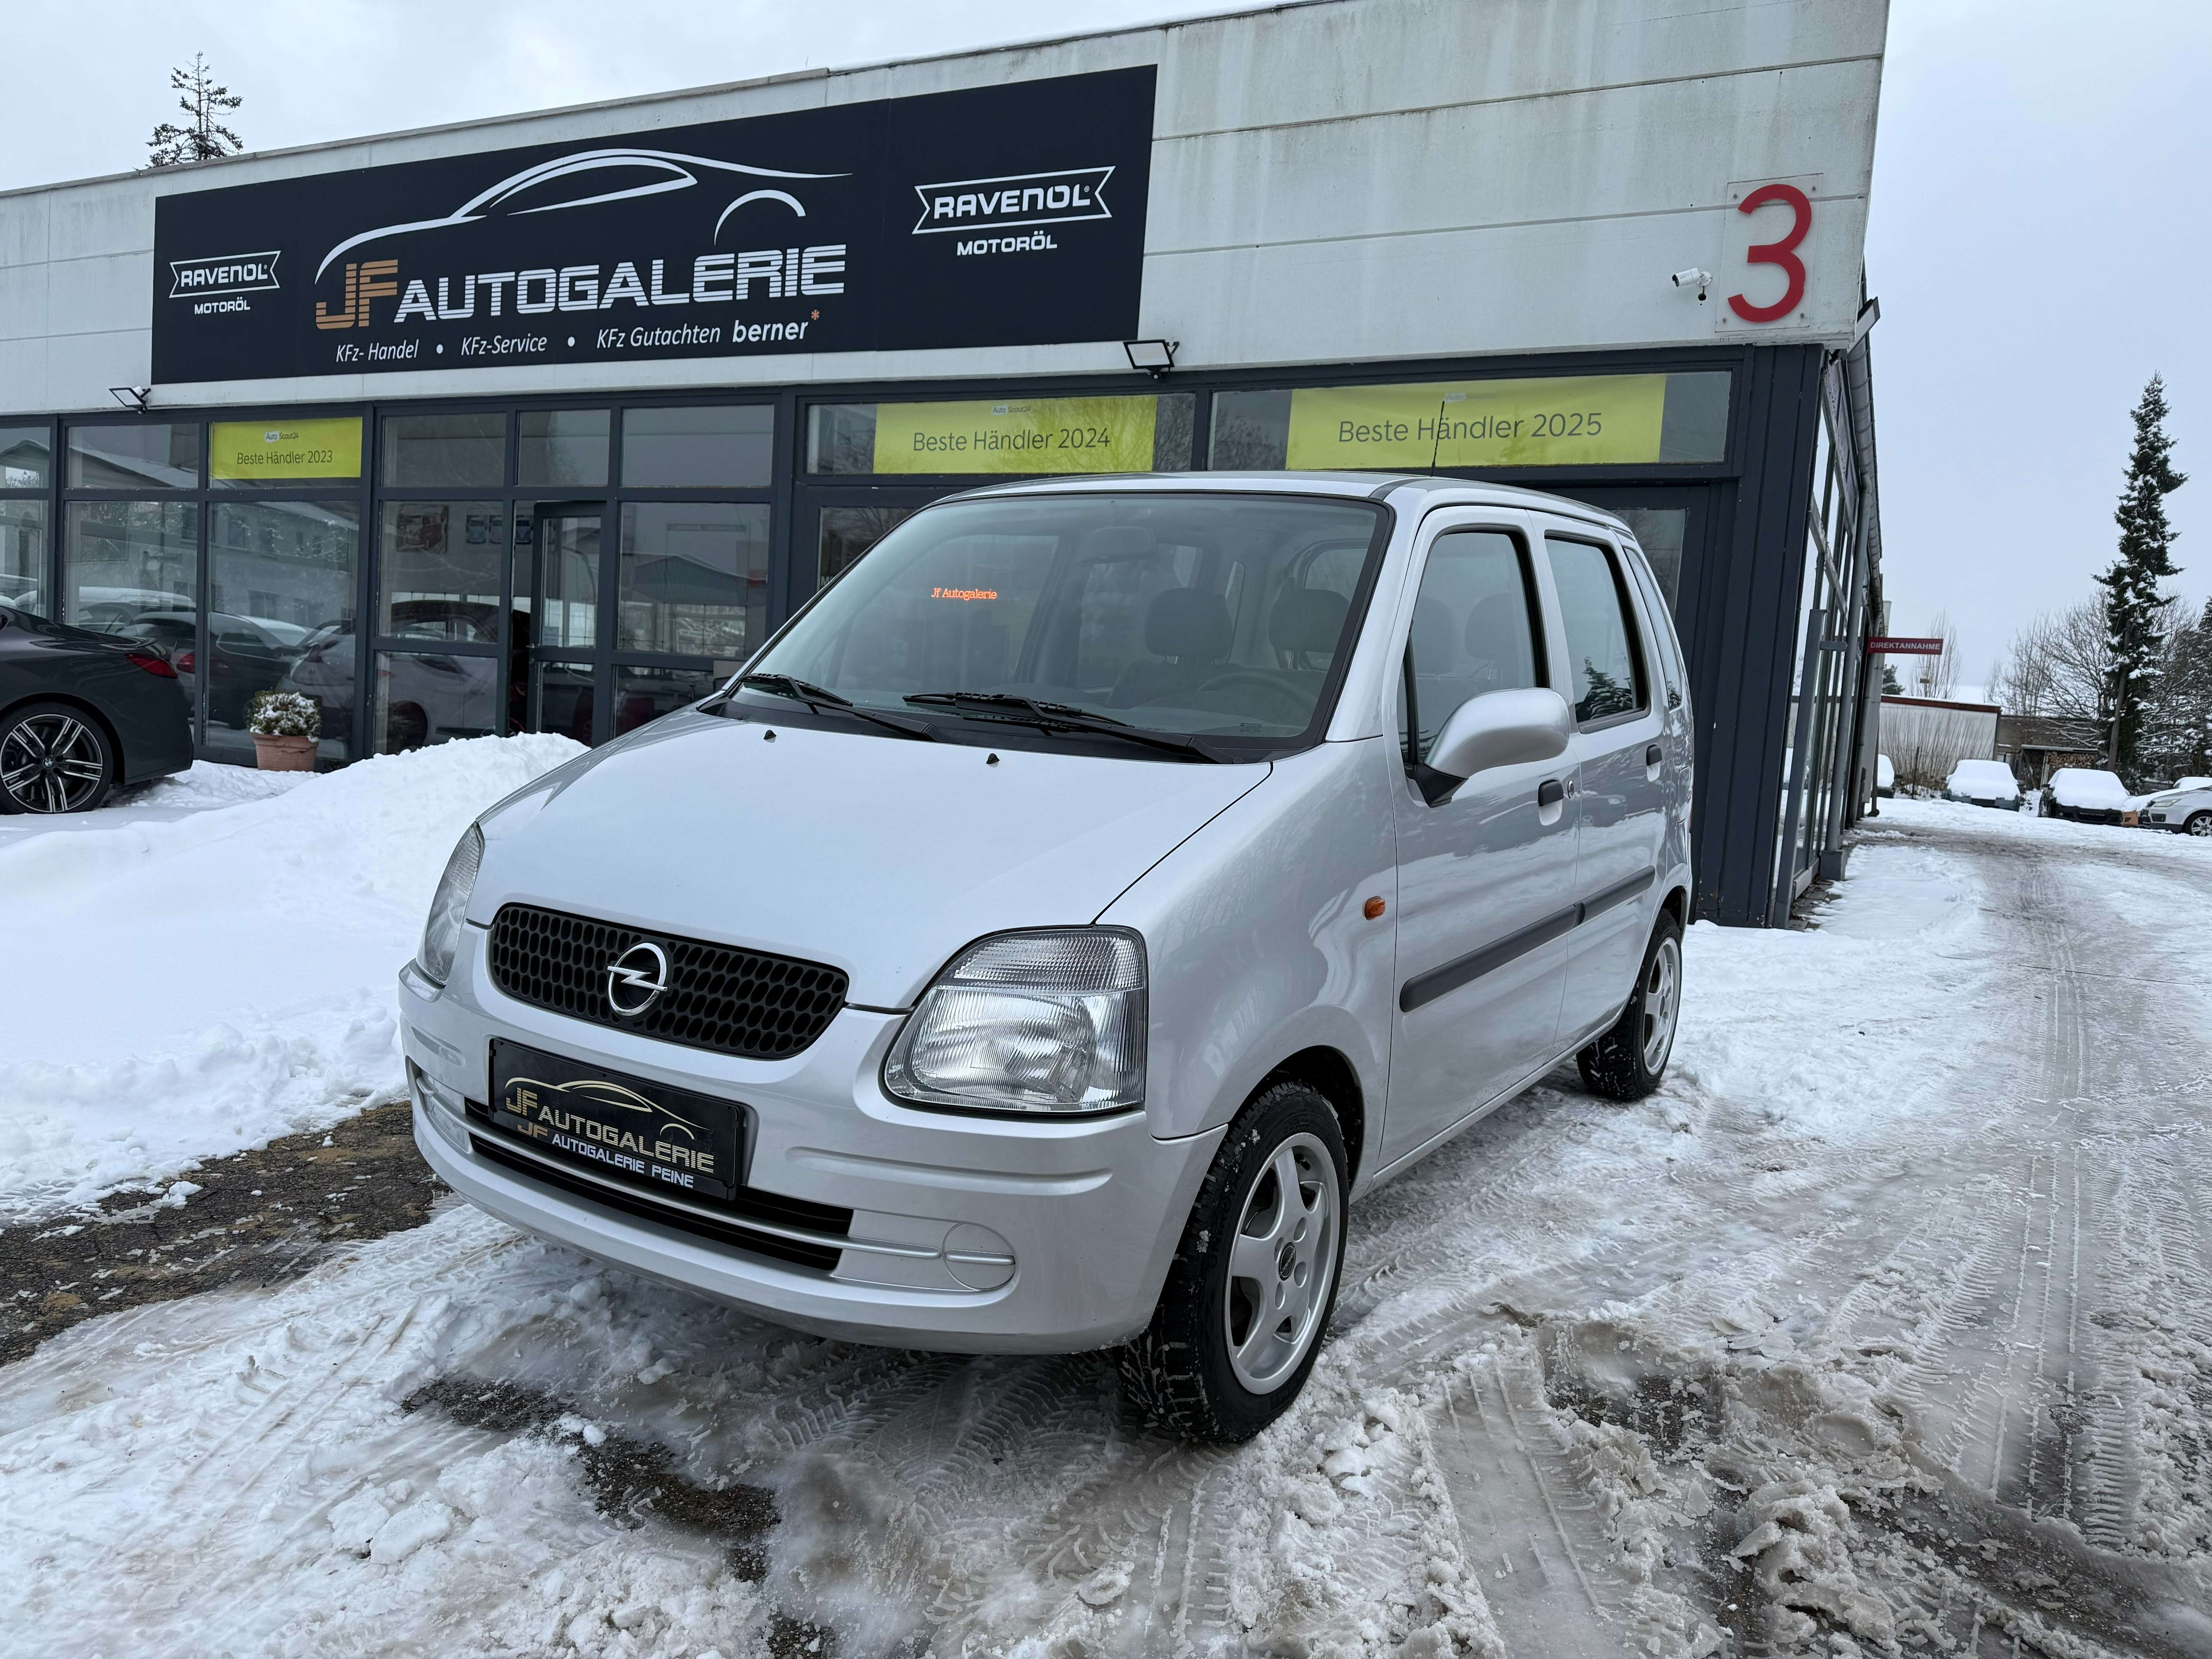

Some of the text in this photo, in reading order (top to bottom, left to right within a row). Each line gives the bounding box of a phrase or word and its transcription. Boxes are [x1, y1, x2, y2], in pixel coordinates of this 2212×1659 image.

[934, 184, 1091, 219] RAVENOL
[957, 230, 1058, 256] MOTORÖL
[1728, 184, 1812, 323] 3
[180, 263, 269, 288] RAVENOL
[393, 244, 847, 323] AUTOGALERIE
[194, 296, 251, 314] MOTORÖL
[368, 339, 418, 361] Handel
[461, 333, 547, 356] KFz-Service
[597, 328, 624, 349] KFz
[630, 324, 721, 346] Gutachten
[732, 319, 808, 343] berner
[914, 427, 1110, 452] Beste Händler 2024
[1339, 412, 1602, 443] Beste Händler 2025
[237, 450, 333, 465] Beste Händler 2023
[942, 588, 998, 601] Autogalerie
[1870, 642, 1940, 650] DIREKTANNAHME
[505, 1087, 714, 1174] JF AUTOGALERIE
[517, 1121, 694, 1189] JF AUTOGALERIE PEINE
